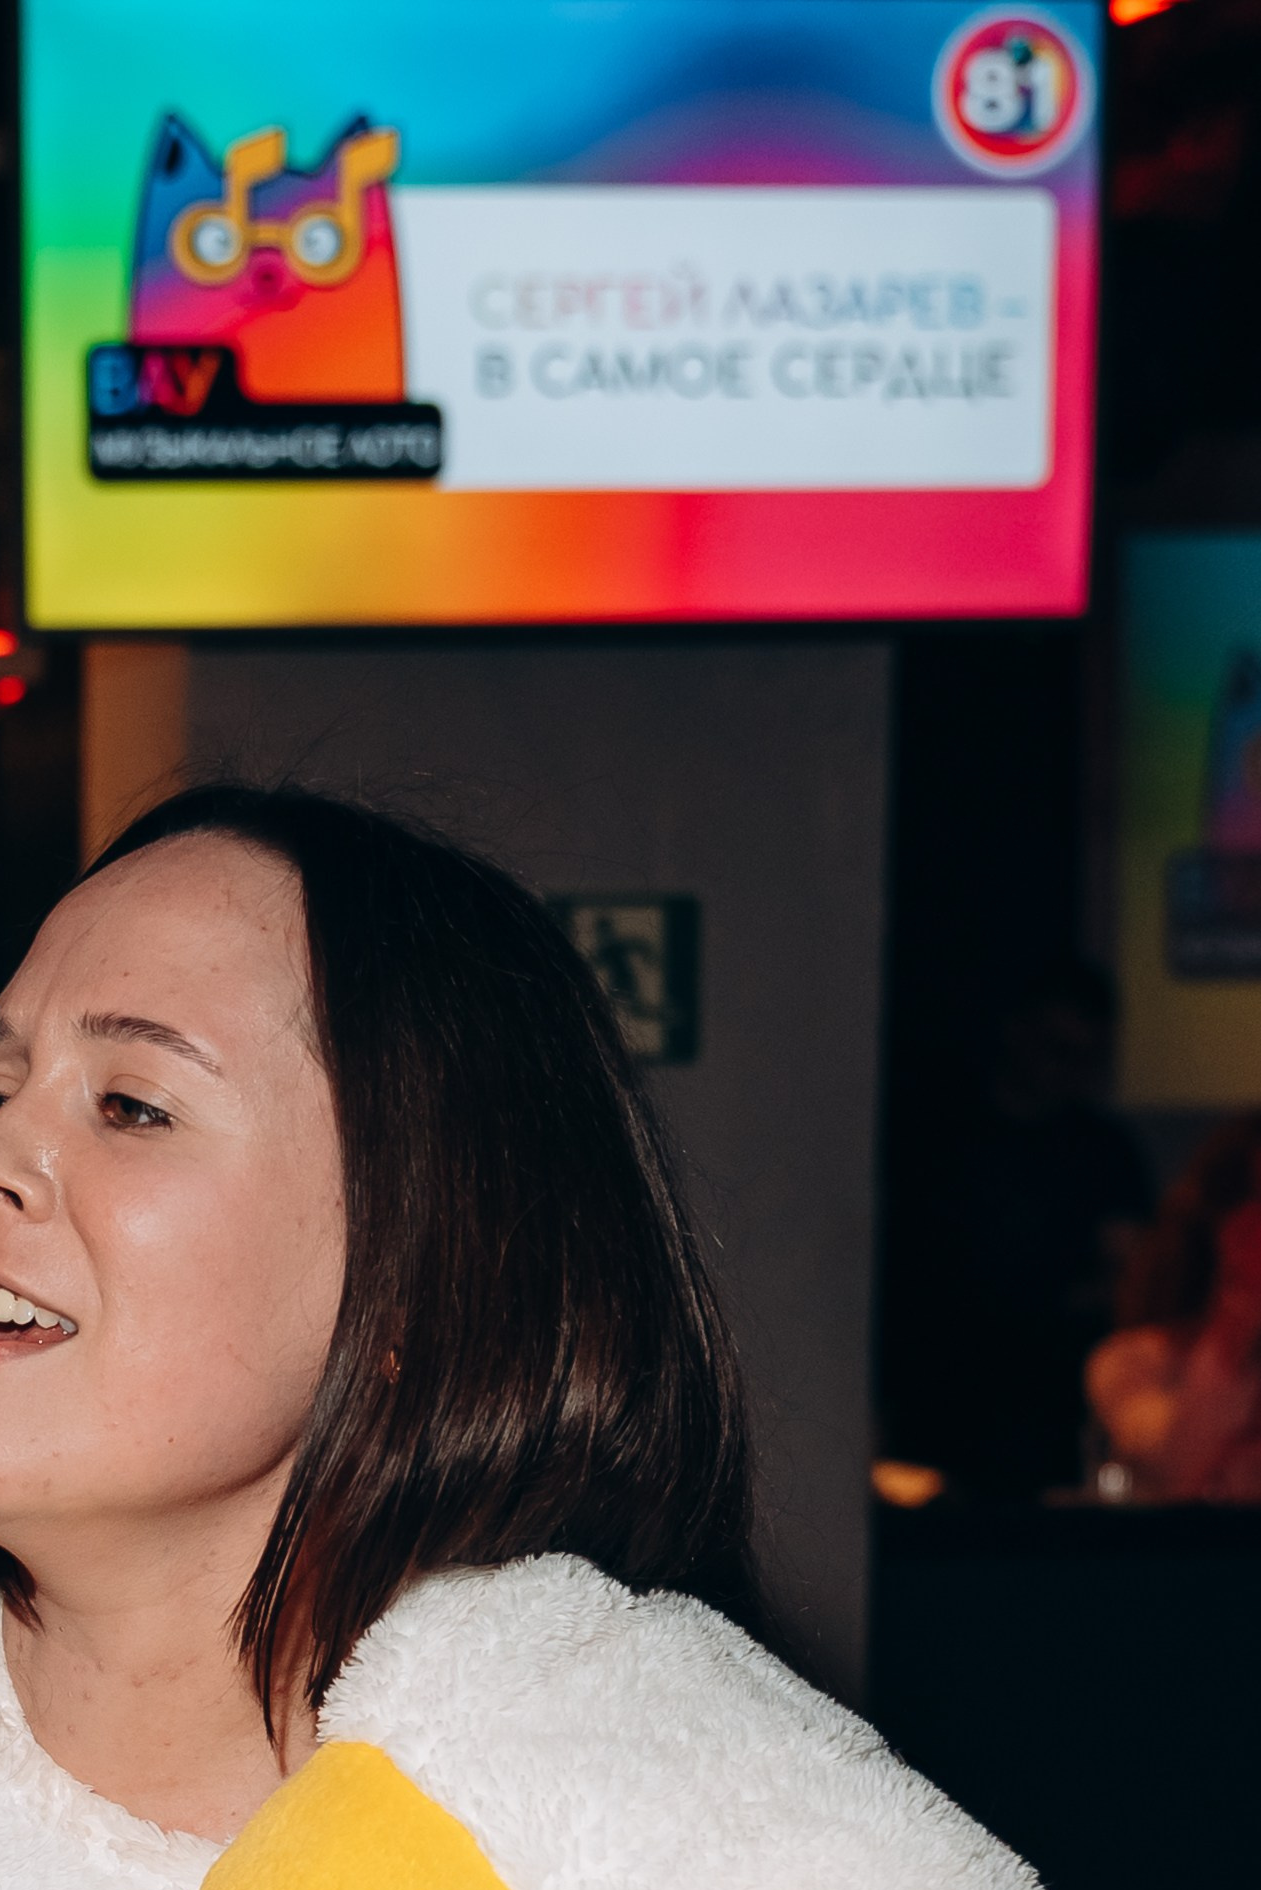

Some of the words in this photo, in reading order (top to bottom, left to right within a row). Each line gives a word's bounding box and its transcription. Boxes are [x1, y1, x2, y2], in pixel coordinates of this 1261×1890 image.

[964, 48, 1056, 132] 81
[470, 263, 706, 330] СЕРГЕЙ
[722, 272, 986, 331] ЛАЗАРЕВ
[91, 350, 222, 416] ВАУ
[474, 341, 515, 398] В
[530, 341, 754, 398] САМОЕ
[769, 339, 1018, 404] СЕРДЦЕ
